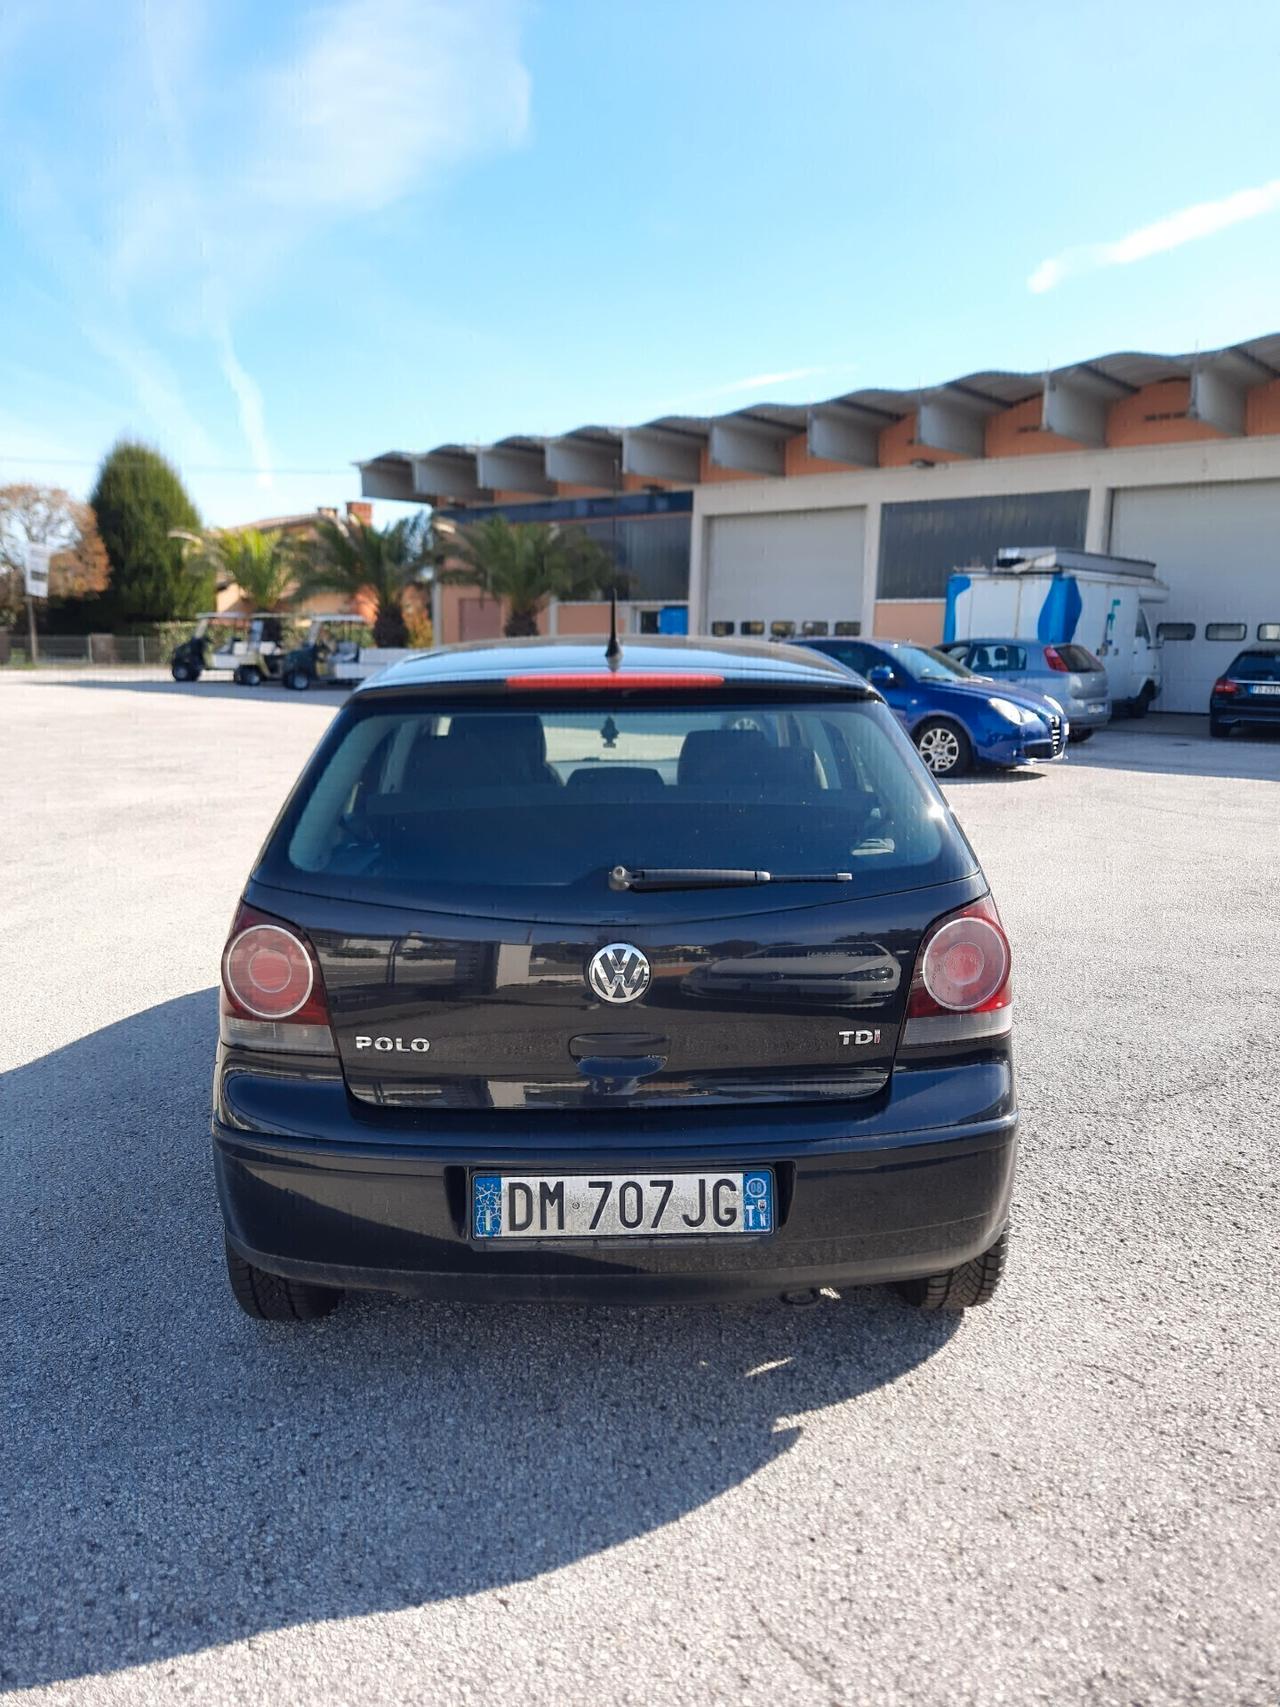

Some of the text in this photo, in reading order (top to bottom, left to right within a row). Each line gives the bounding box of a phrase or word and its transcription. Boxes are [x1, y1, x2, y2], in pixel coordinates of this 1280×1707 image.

[589, 943, 650, 1003] VW
[355, 1036, 430, 1053] POLO
[508, 1179, 738, 1231] DM 707 JG
